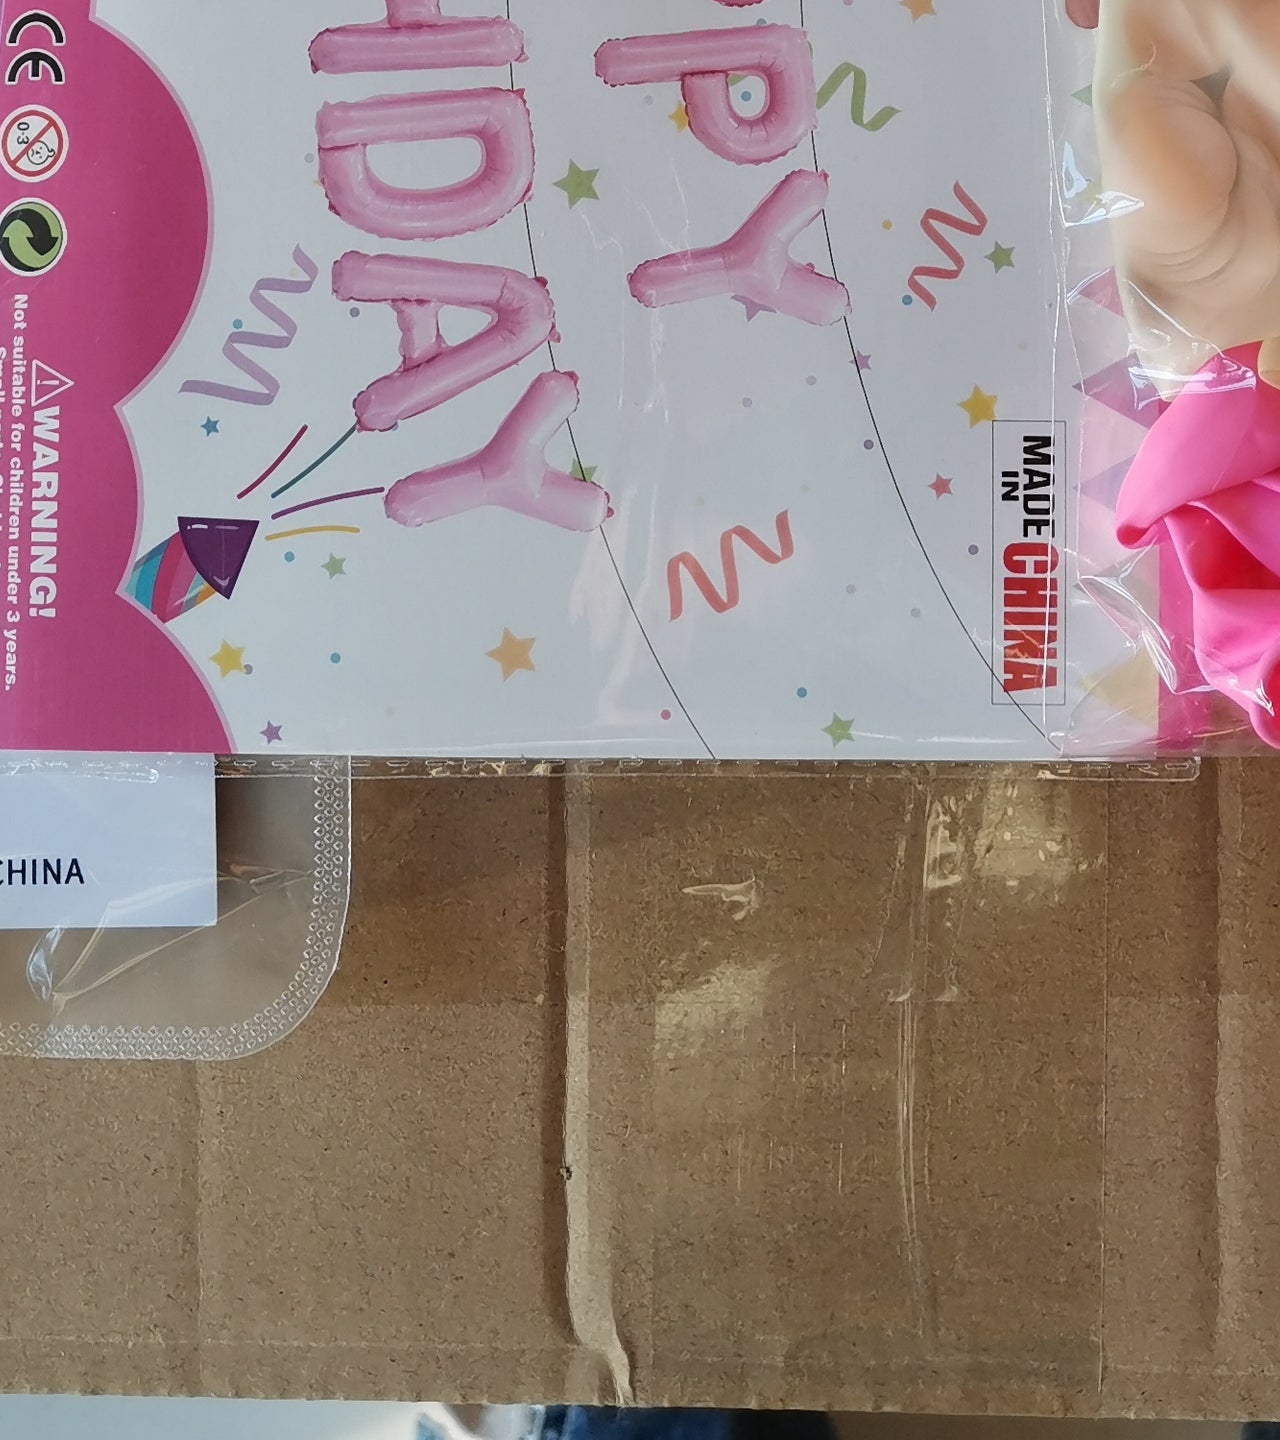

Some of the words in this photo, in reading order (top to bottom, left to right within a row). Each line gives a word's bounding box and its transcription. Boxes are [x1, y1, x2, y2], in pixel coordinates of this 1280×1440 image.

[14, 294, 28, 330] Not
[11, 335, 28, 417] suitable
[10, 422, 24, 453] for
[8, 456, 24, 540] children
[29, 405, 60, 618] WARNING!
[1001, 471, 1019, 501] IN
[1022, 435, 1055, 538] MADE
[7, 545, 21, 604] under
[7, 610, 20, 622] 3
[1003, 542, 1059, 693] CHINA
[3, 628, 18, 690] years.
